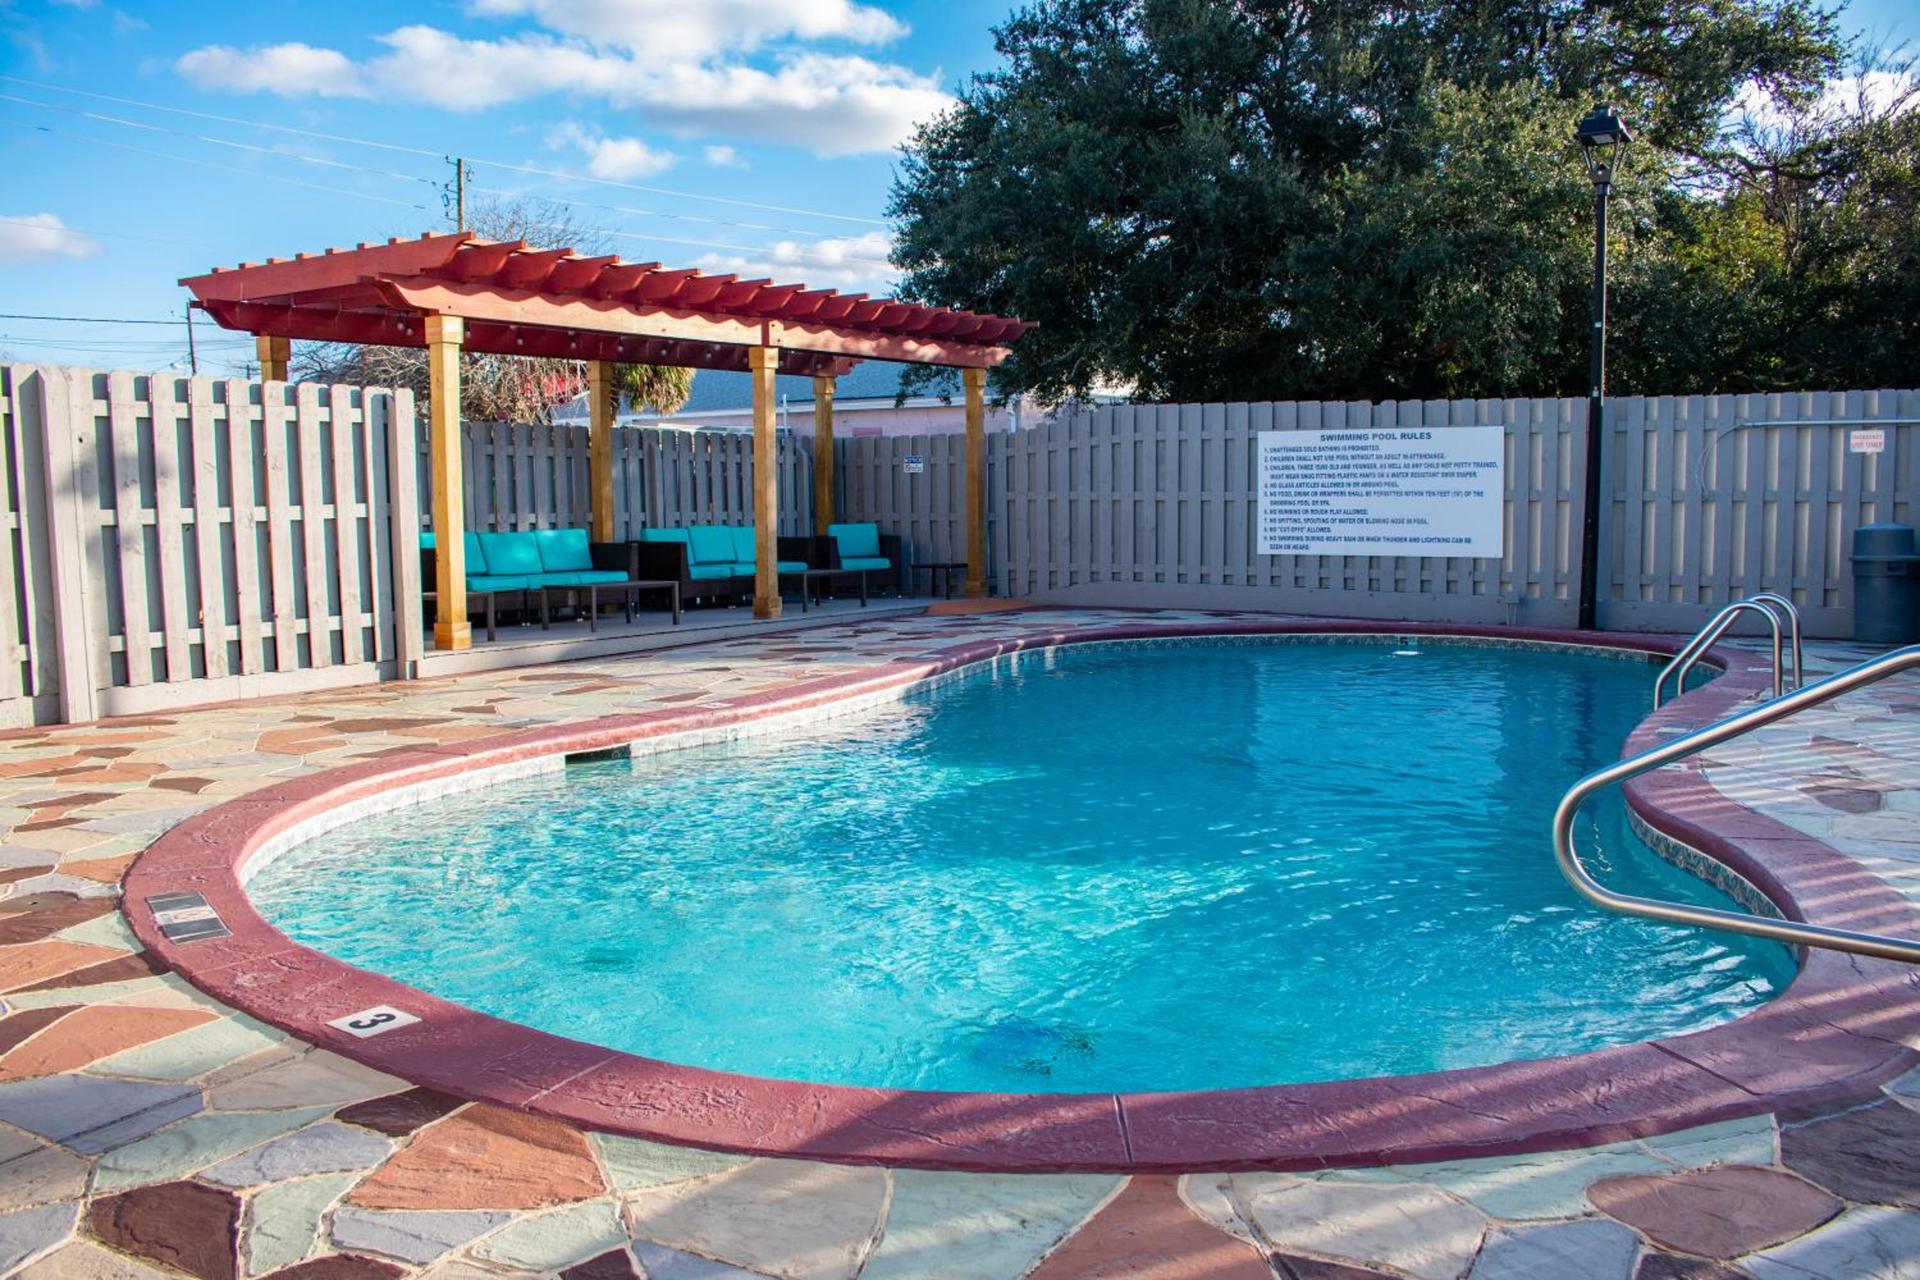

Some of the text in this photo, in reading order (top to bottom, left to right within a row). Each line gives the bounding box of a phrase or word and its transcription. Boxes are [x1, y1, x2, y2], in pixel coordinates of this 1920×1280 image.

[1320, 433, 1369, 441] SWIMMING
[1400, 432, 1432, 440] RULES
[348, 1013, 396, 1029] 3
